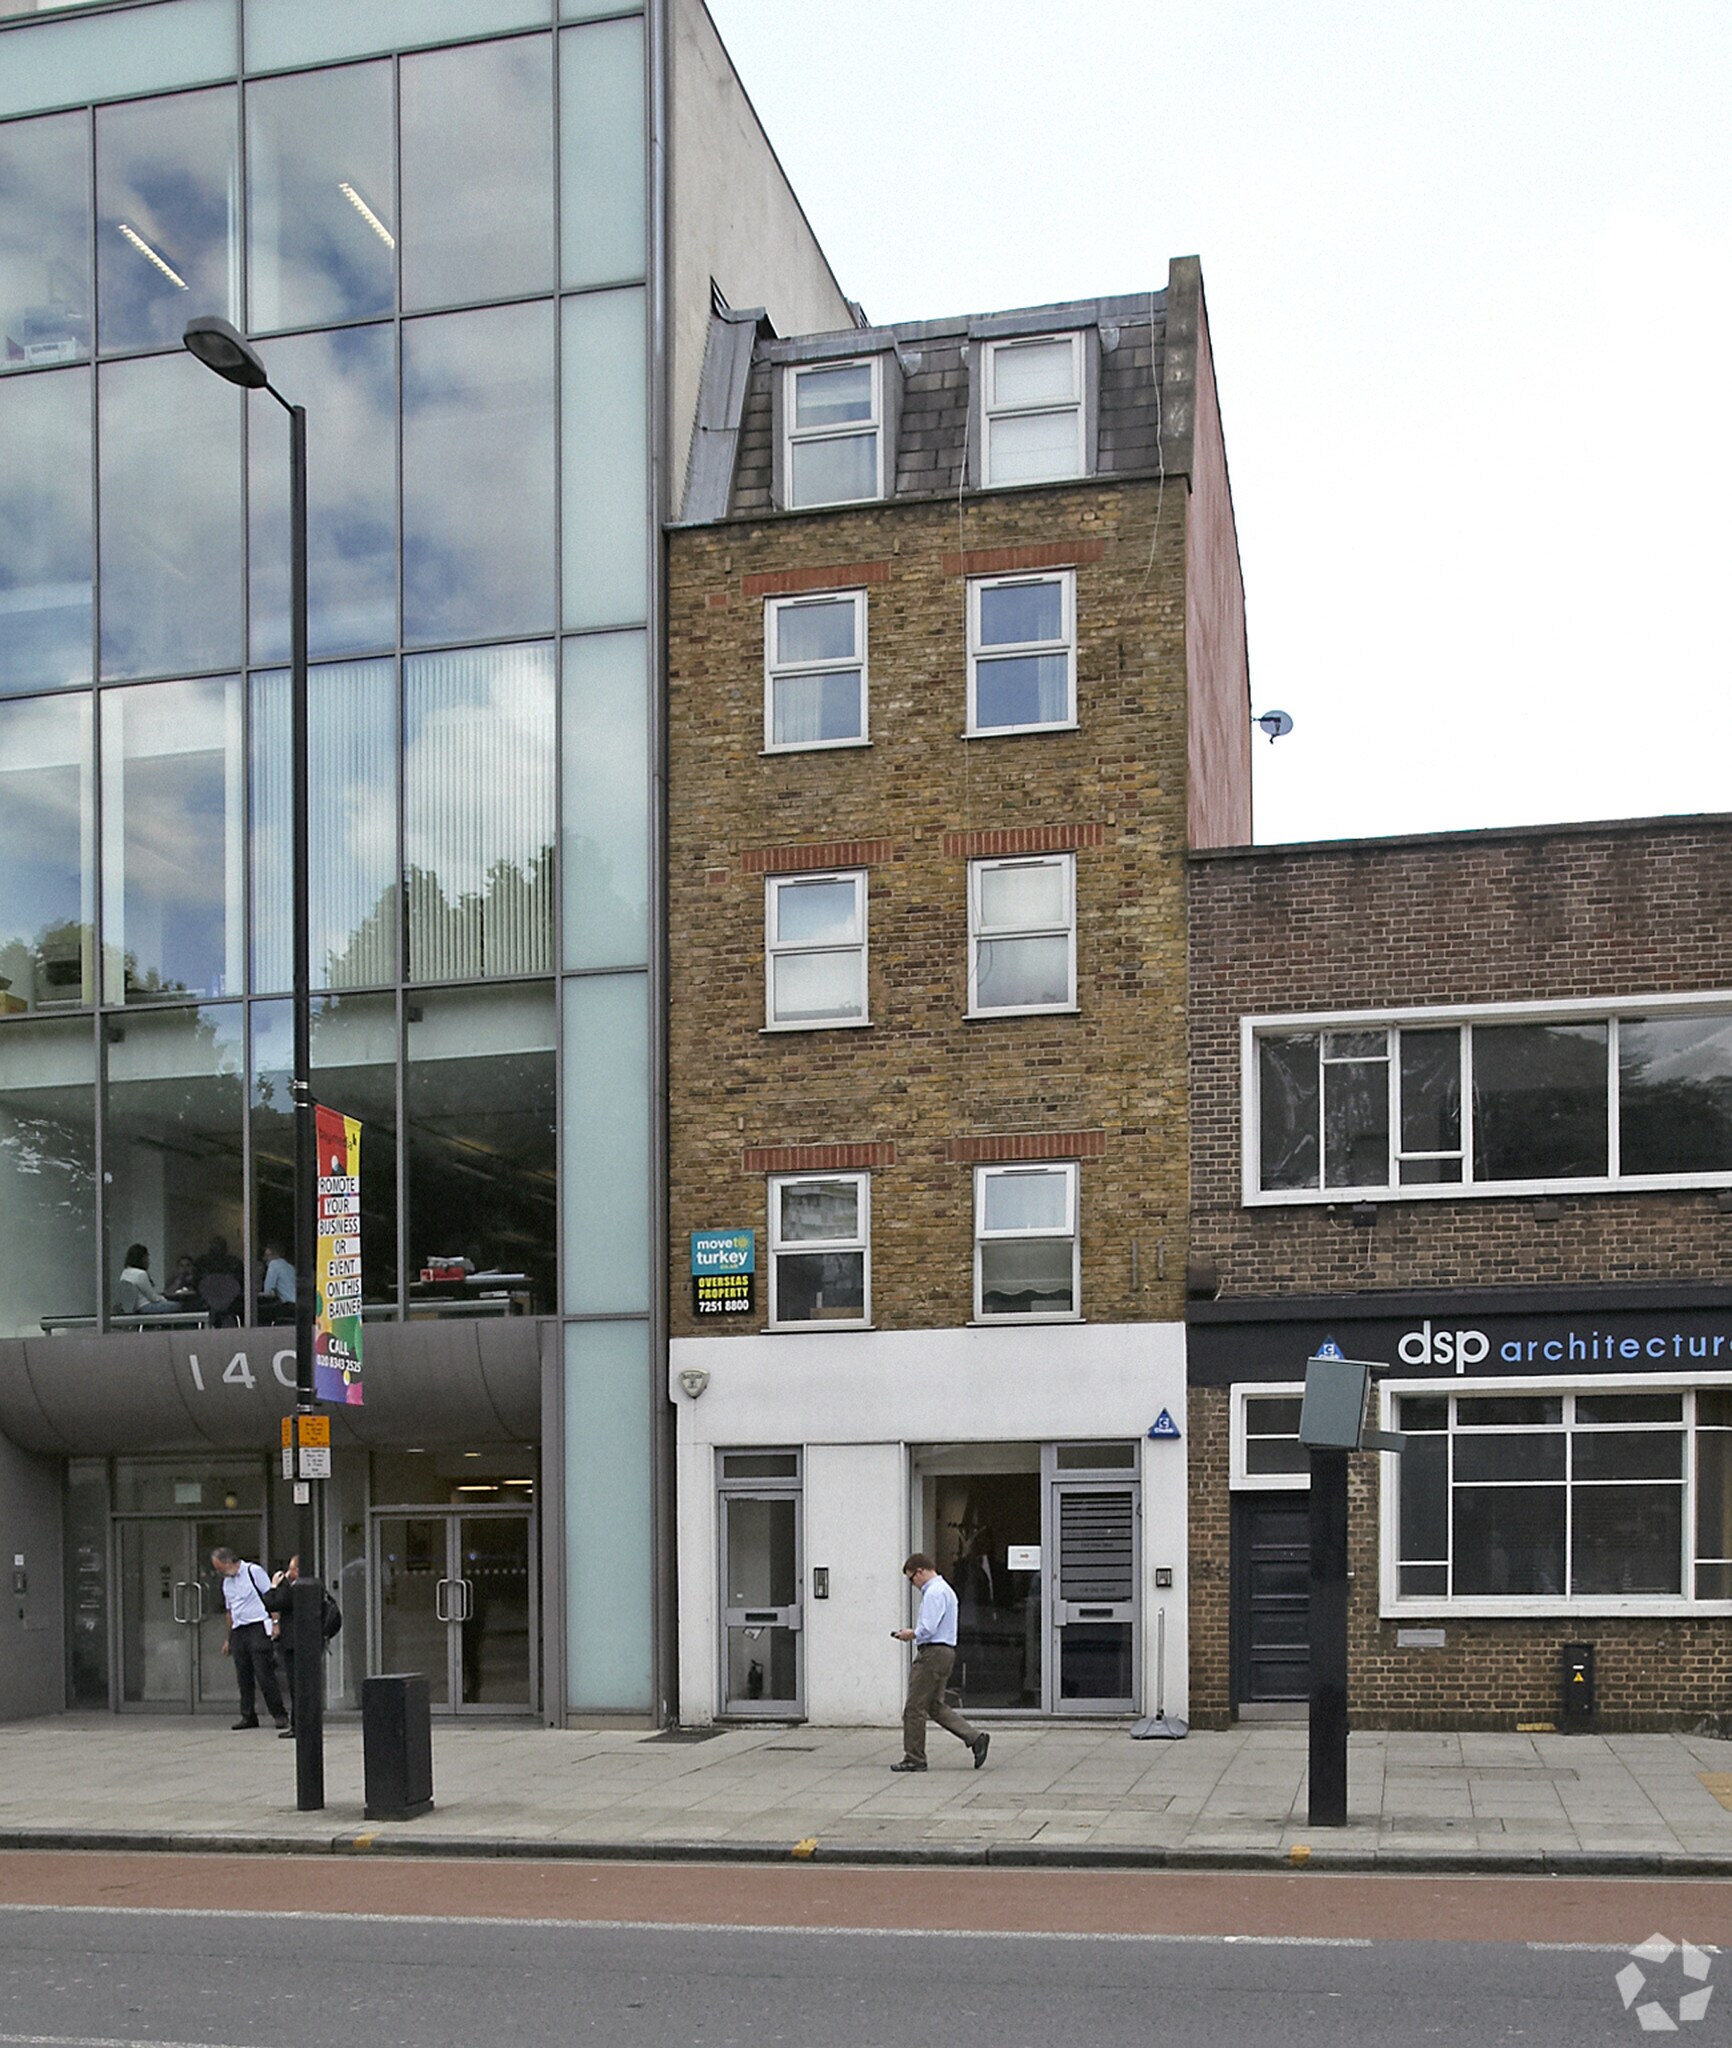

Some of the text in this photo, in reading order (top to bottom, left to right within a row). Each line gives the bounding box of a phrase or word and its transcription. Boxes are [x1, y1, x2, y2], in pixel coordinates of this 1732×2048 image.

[326, 1198, 350, 1213] YOUR
[320, 1218, 358, 1235] BUSINESS
[334, 1239, 347, 1255] OR
[696, 1250, 748, 1265] turkey
[329, 1259, 355, 1276] EVENT
[698, 1275, 749, 1288] OVERSEAS
[698, 1287, 749, 1300] PROPERTY
[328, 1299, 361, 1319] BANNER
[699, 1299, 749, 1313] 7251 8800
[328, 1338, 350, 1356] CALL
[1397, 1320, 1732, 1375] dsp architectur
[329, 1356, 345, 1370] 8343
[345, 1359, 362, 1373] 2525
